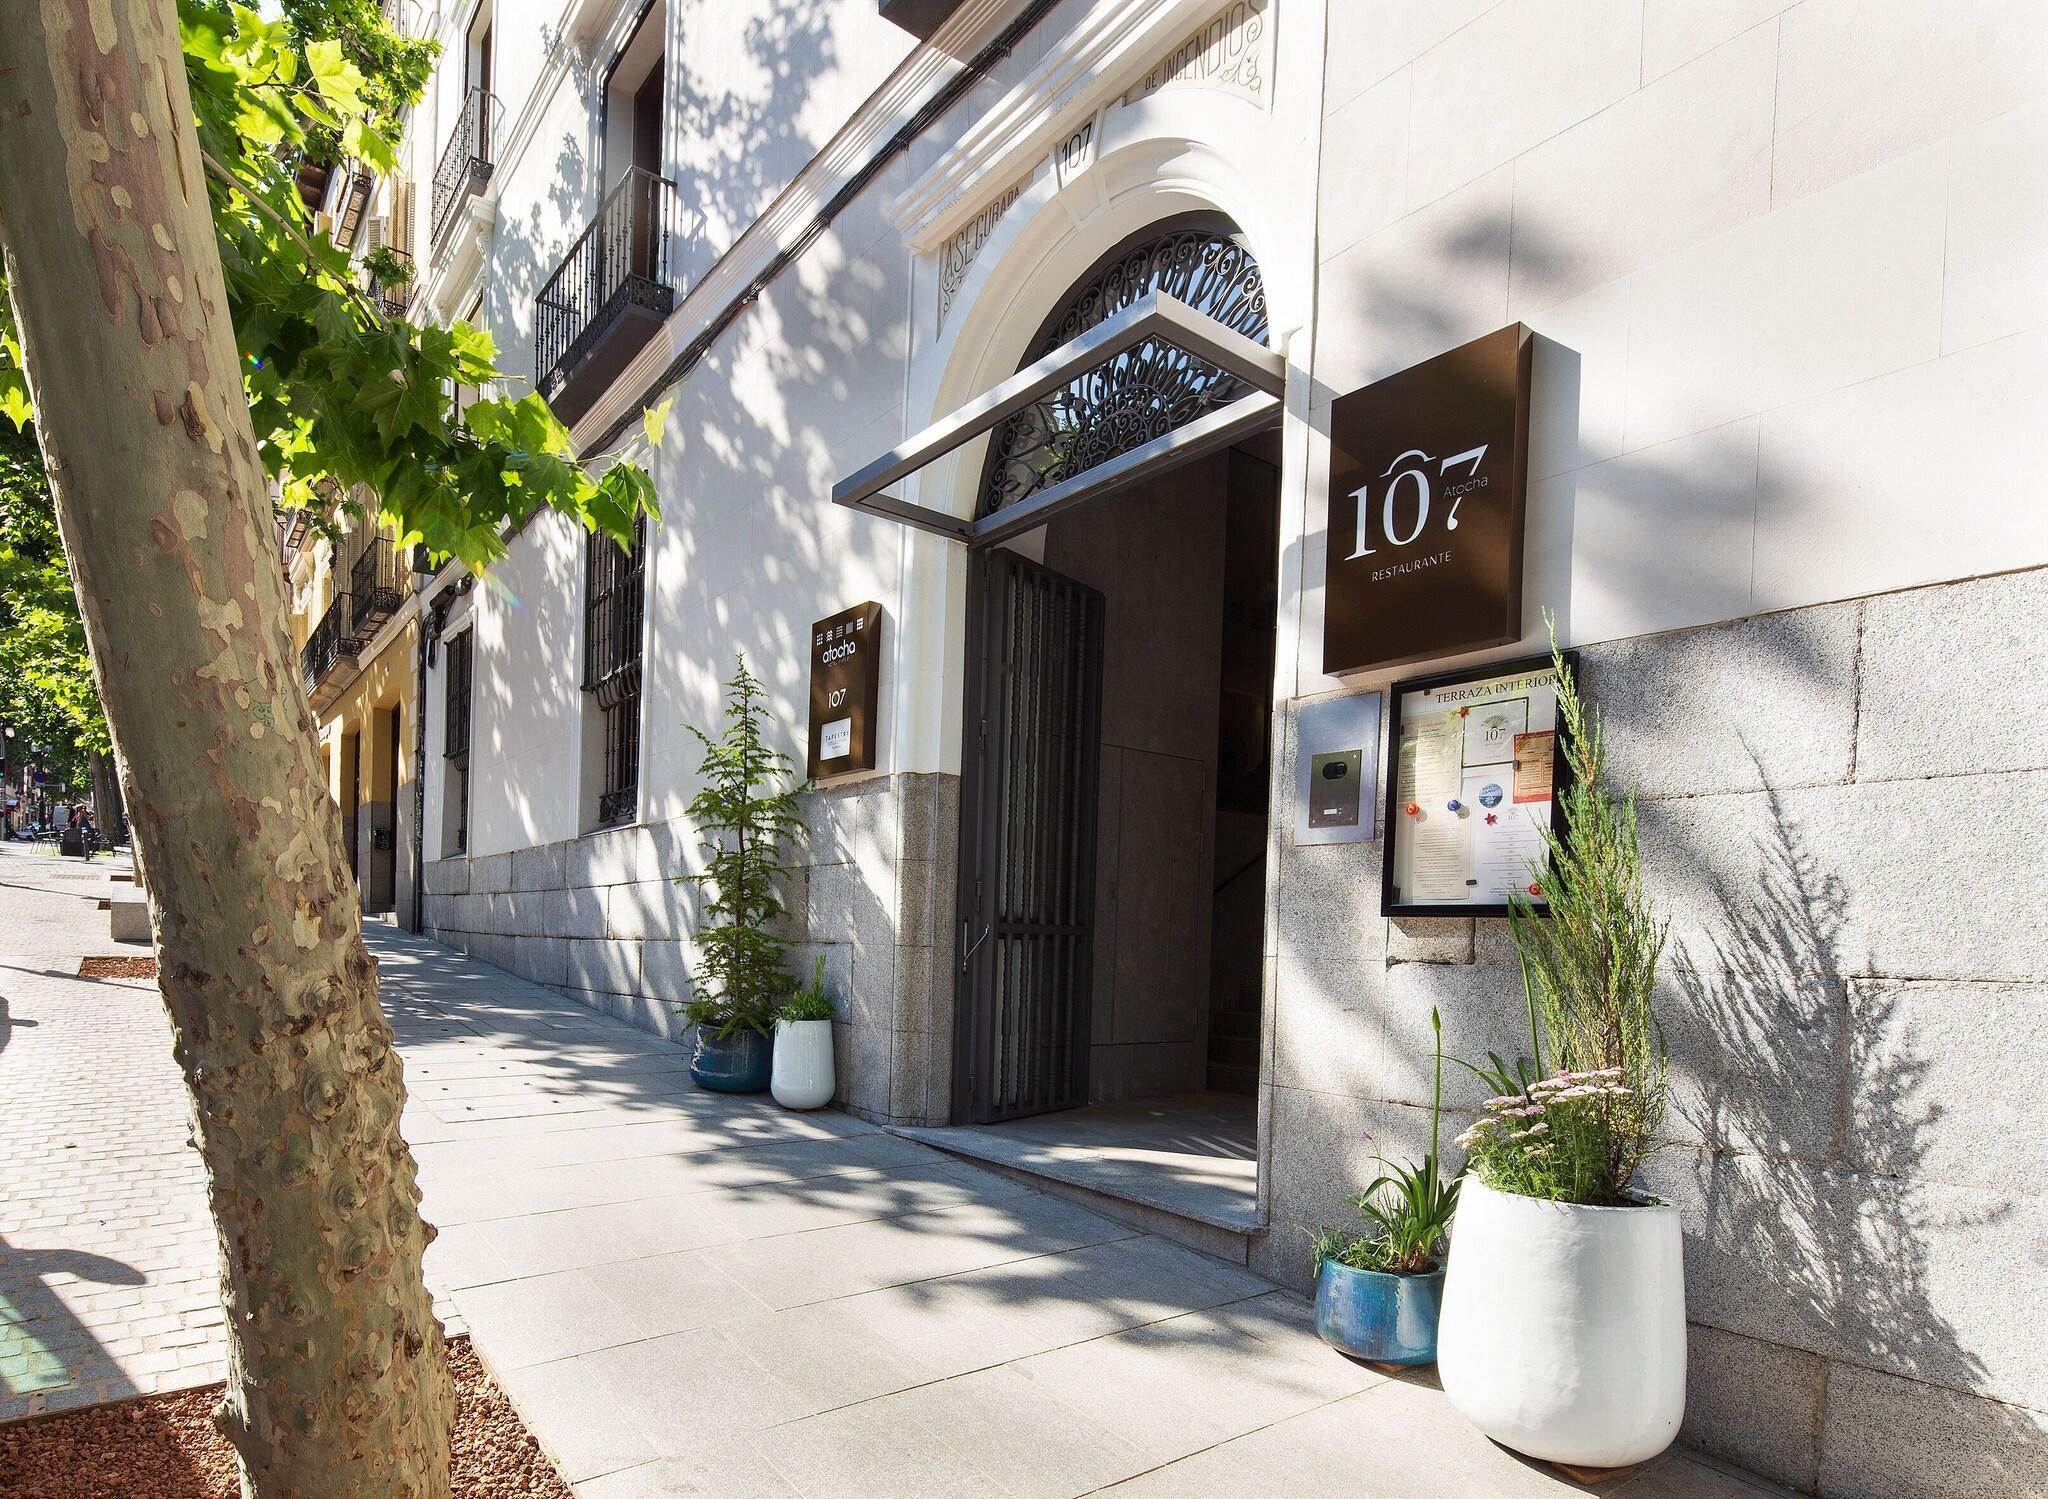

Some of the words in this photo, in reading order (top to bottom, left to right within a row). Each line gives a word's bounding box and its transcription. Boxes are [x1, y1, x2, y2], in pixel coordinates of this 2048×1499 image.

[1145, 70, 1158, 91] DE
[1163, 0, 1263, 84] INCENDIOS
[1061, 121, 1092, 176] 107
[944, 186, 1020, 276] ASEGURADA
[1443, 475, 1488, 499] Atocha
[1344, 443, 1489, 561] 107
[1371, 550, 1452, 582] RESTAURANTE
[822, 639, 856, 664] atocha
[828, 687, 847, 709] 107
[1436, 686, 1492, 704] TERRAZA
[825, 730, 849, 742] TAPESTRY
[1484, 727, 1506, 742] 107
